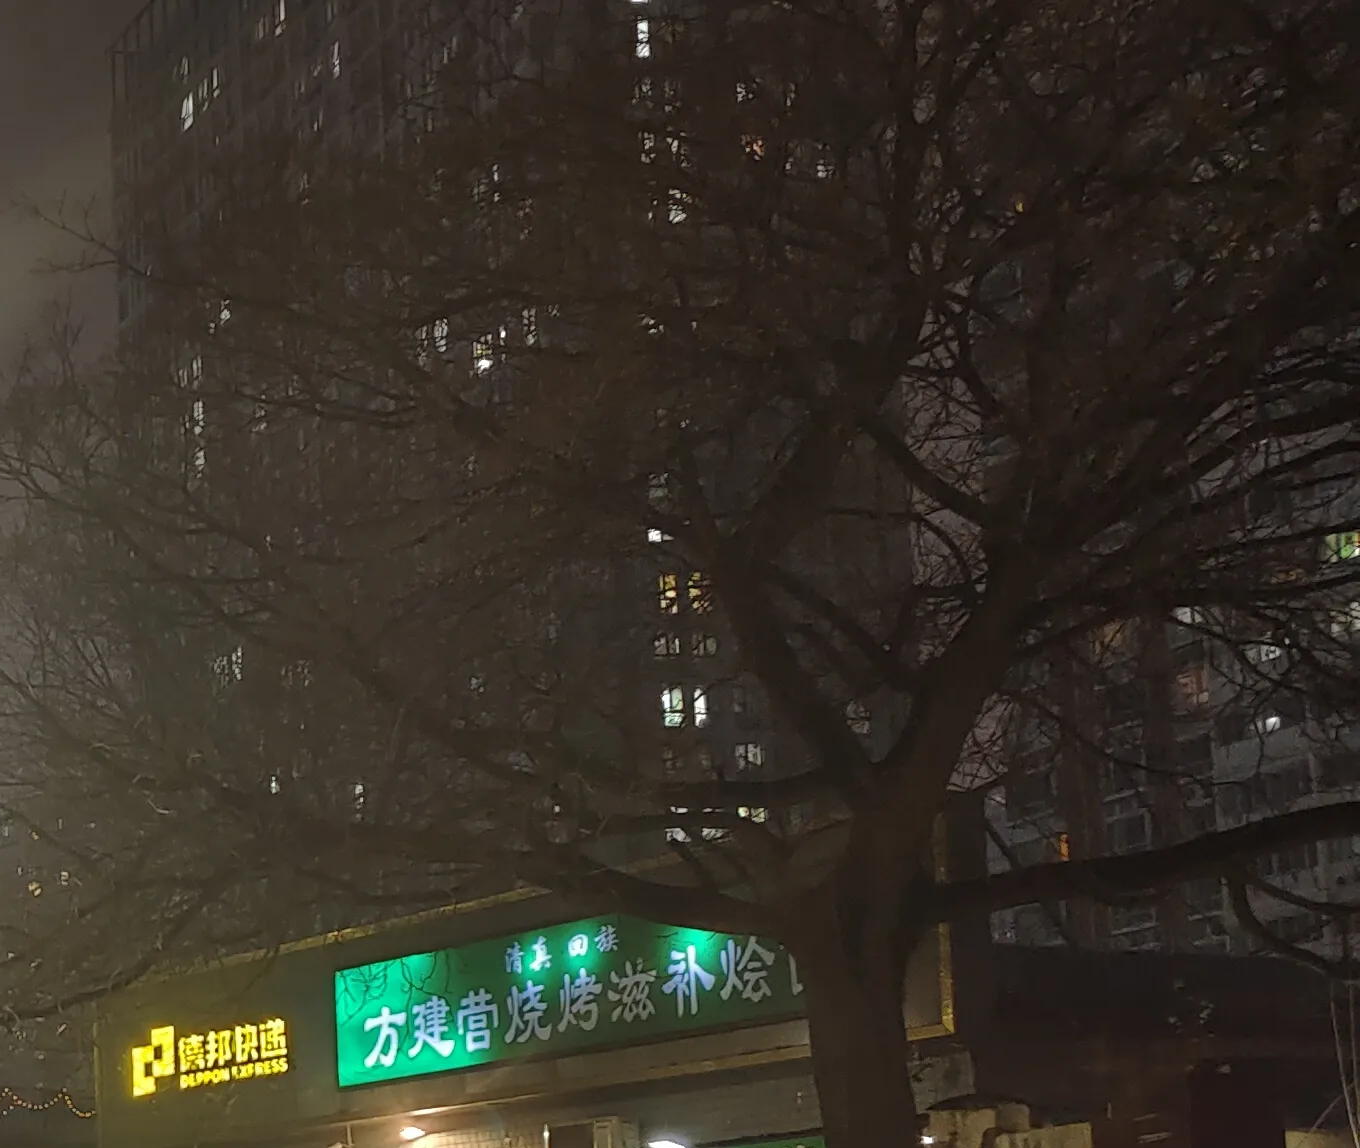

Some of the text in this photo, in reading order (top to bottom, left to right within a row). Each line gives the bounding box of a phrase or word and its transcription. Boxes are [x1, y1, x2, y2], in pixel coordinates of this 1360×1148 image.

[504, 924, 620, 975] 清真 回族
[362, 935, 804, 1069] 方建营烧烤滋补烩
